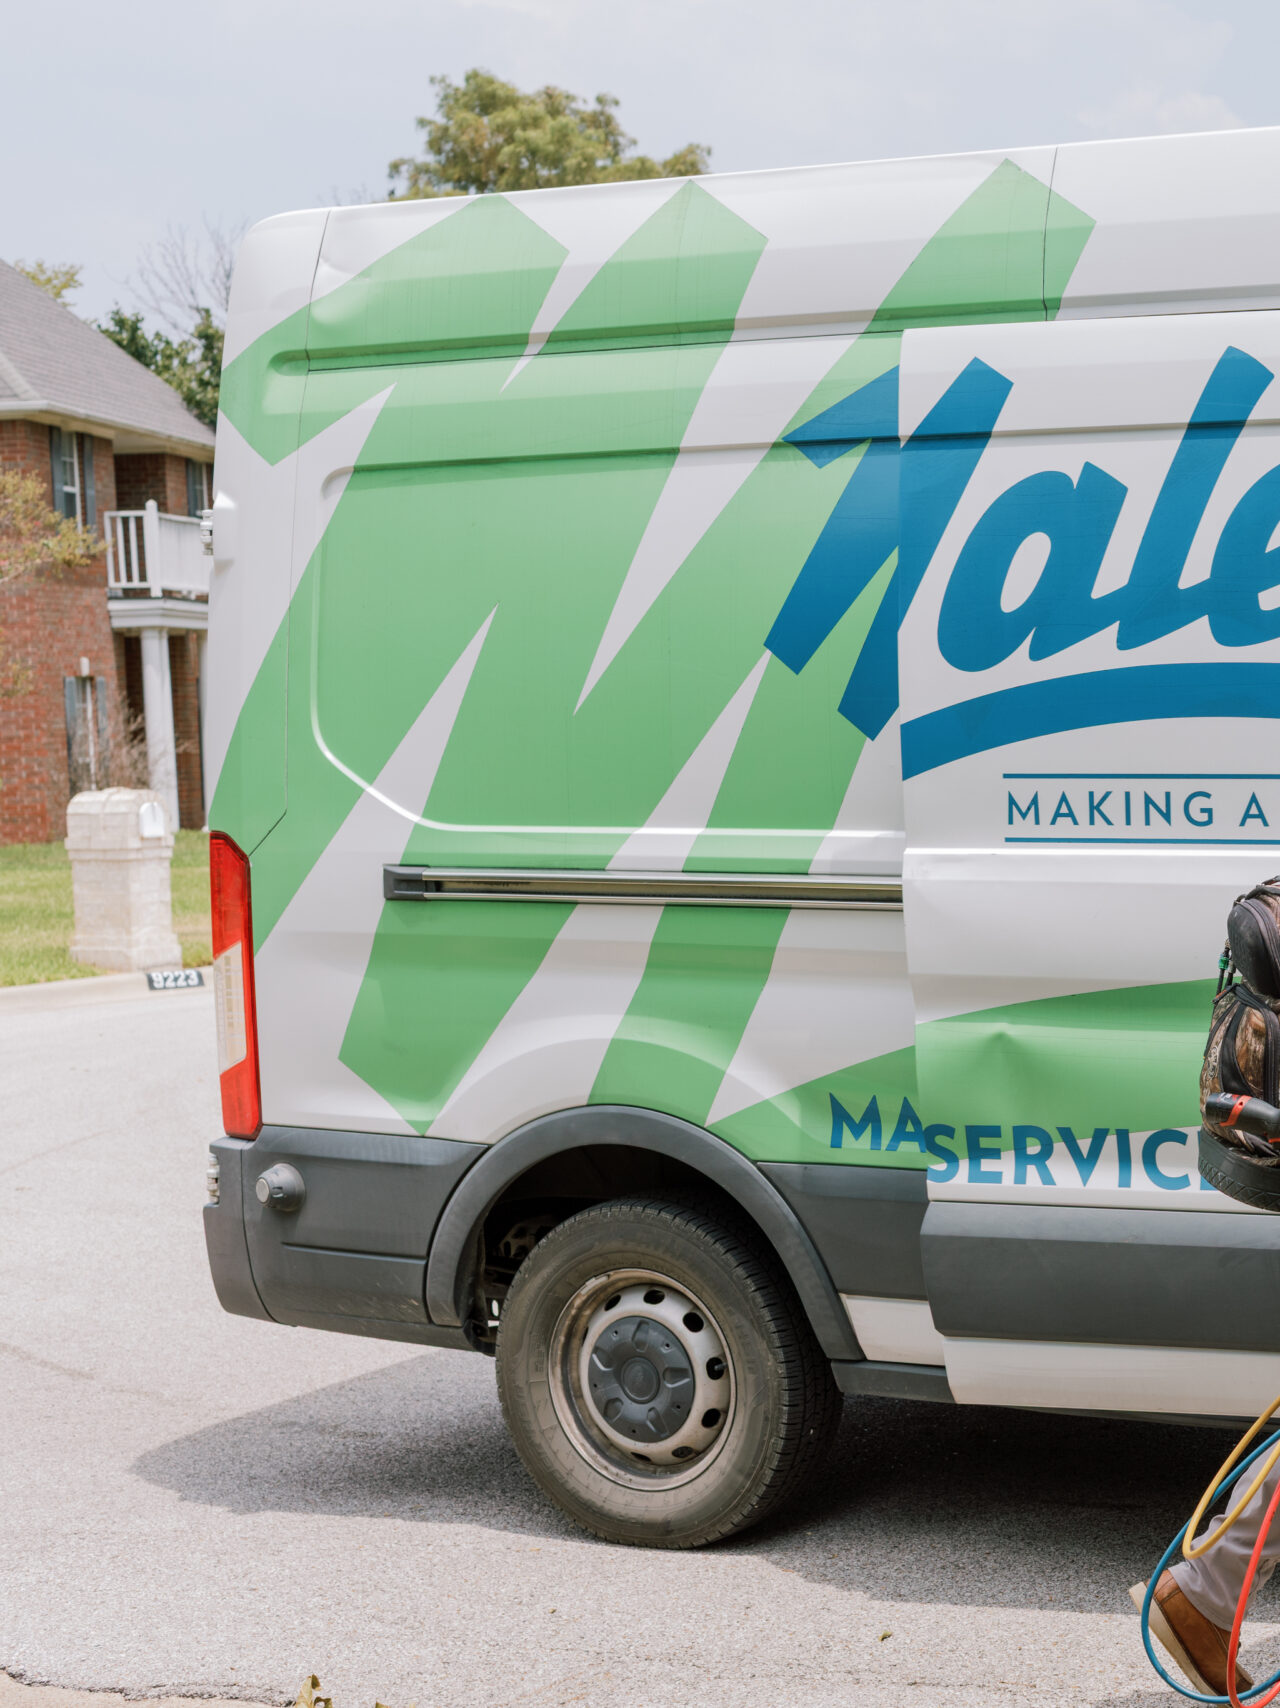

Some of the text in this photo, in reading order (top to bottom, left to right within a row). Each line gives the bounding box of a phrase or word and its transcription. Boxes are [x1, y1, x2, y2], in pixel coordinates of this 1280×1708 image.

[1007, 791, 1214, 827] MAKING
[1239, 792, 1270, 827] A
[151, 969, 199, 989] 9223
[924, 1123, 1217, 1191] SERVIC
